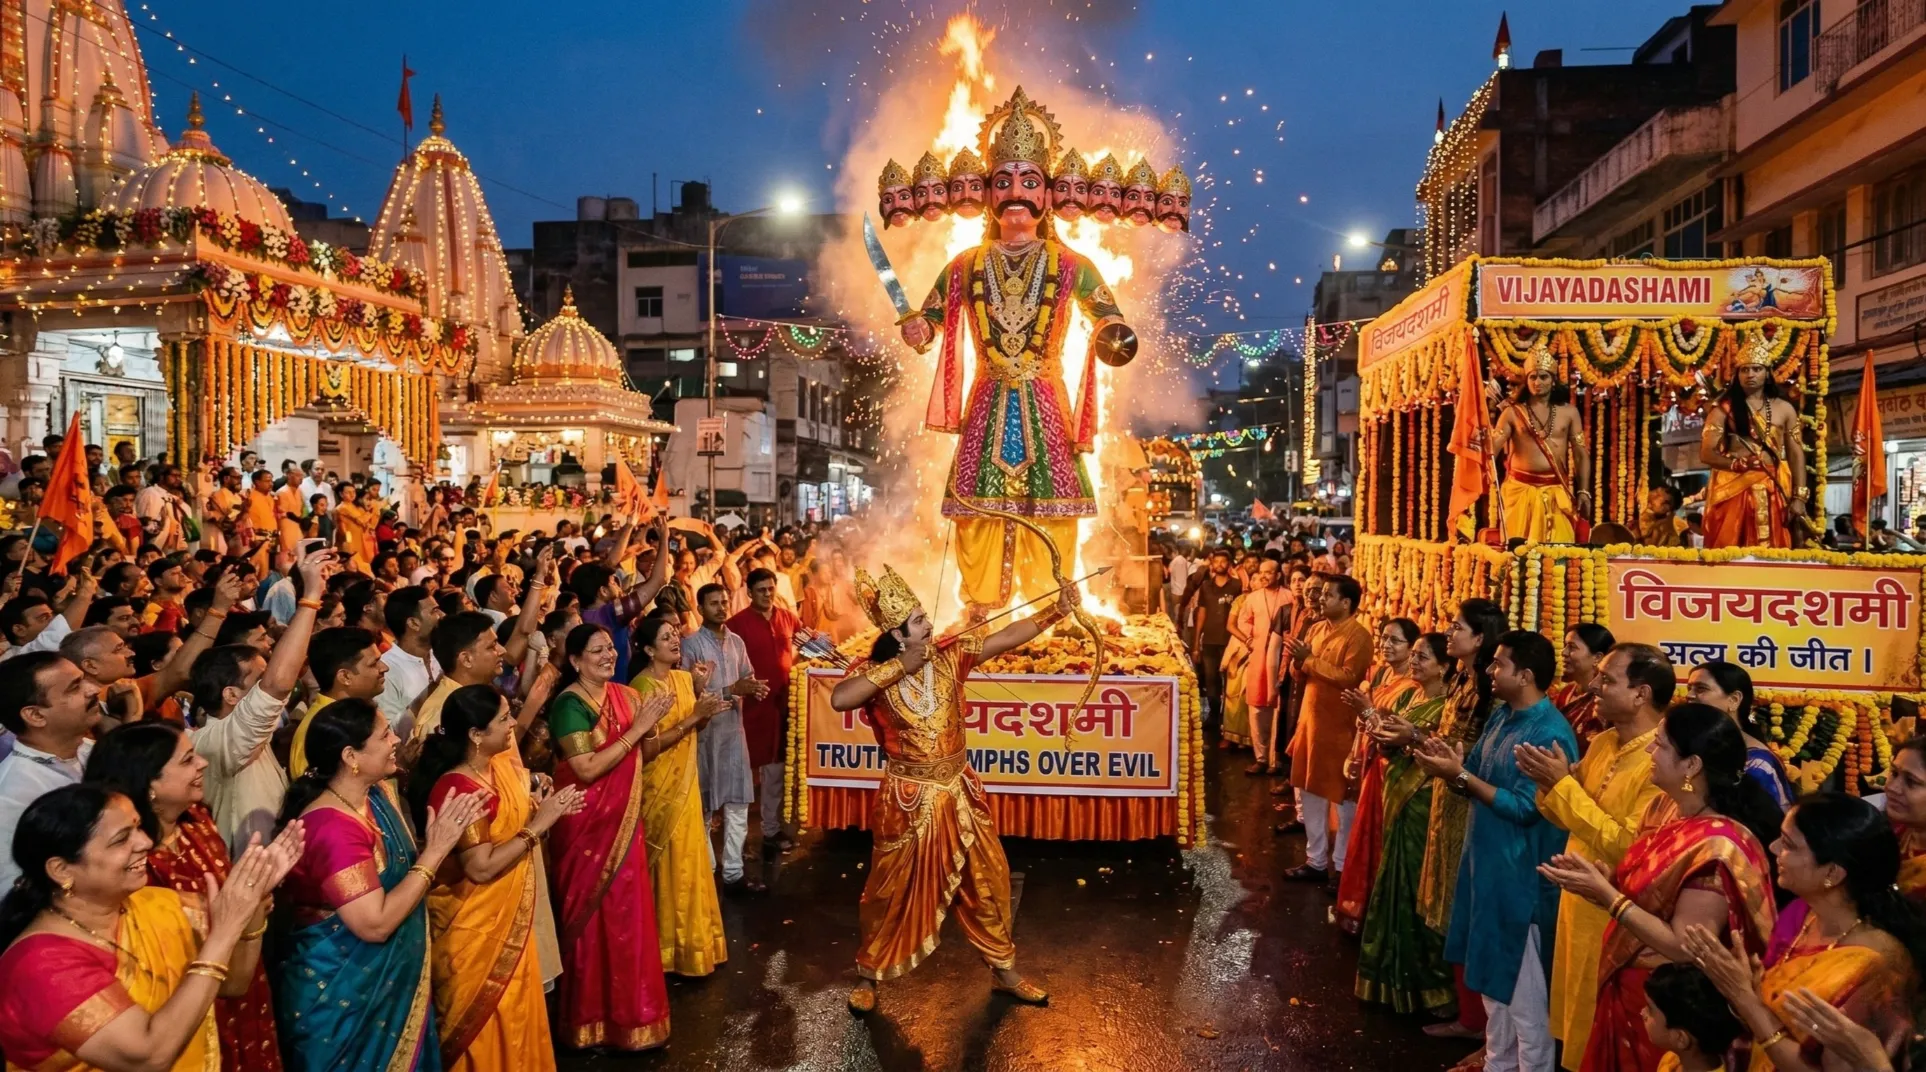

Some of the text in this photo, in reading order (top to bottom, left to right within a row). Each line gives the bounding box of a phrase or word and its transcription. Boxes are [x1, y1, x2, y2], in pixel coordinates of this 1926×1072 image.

[1498, 277, 1711, 304] VIJAYADASHAMI
[1371, 286, 1450, 356] विजयदशमी
[1619, 567, 1912, 629] विजयदशमी
[1658, 642, 1728, 665] सत्य
[1737, 636, 1778, 669] की
[1788, 637, 1852, 672] जीत
[966, 748, 1029, 775] MPHS
[1038, 750, 1101, 776] OVER
[1108, 752, 1160, 778] EVIL
